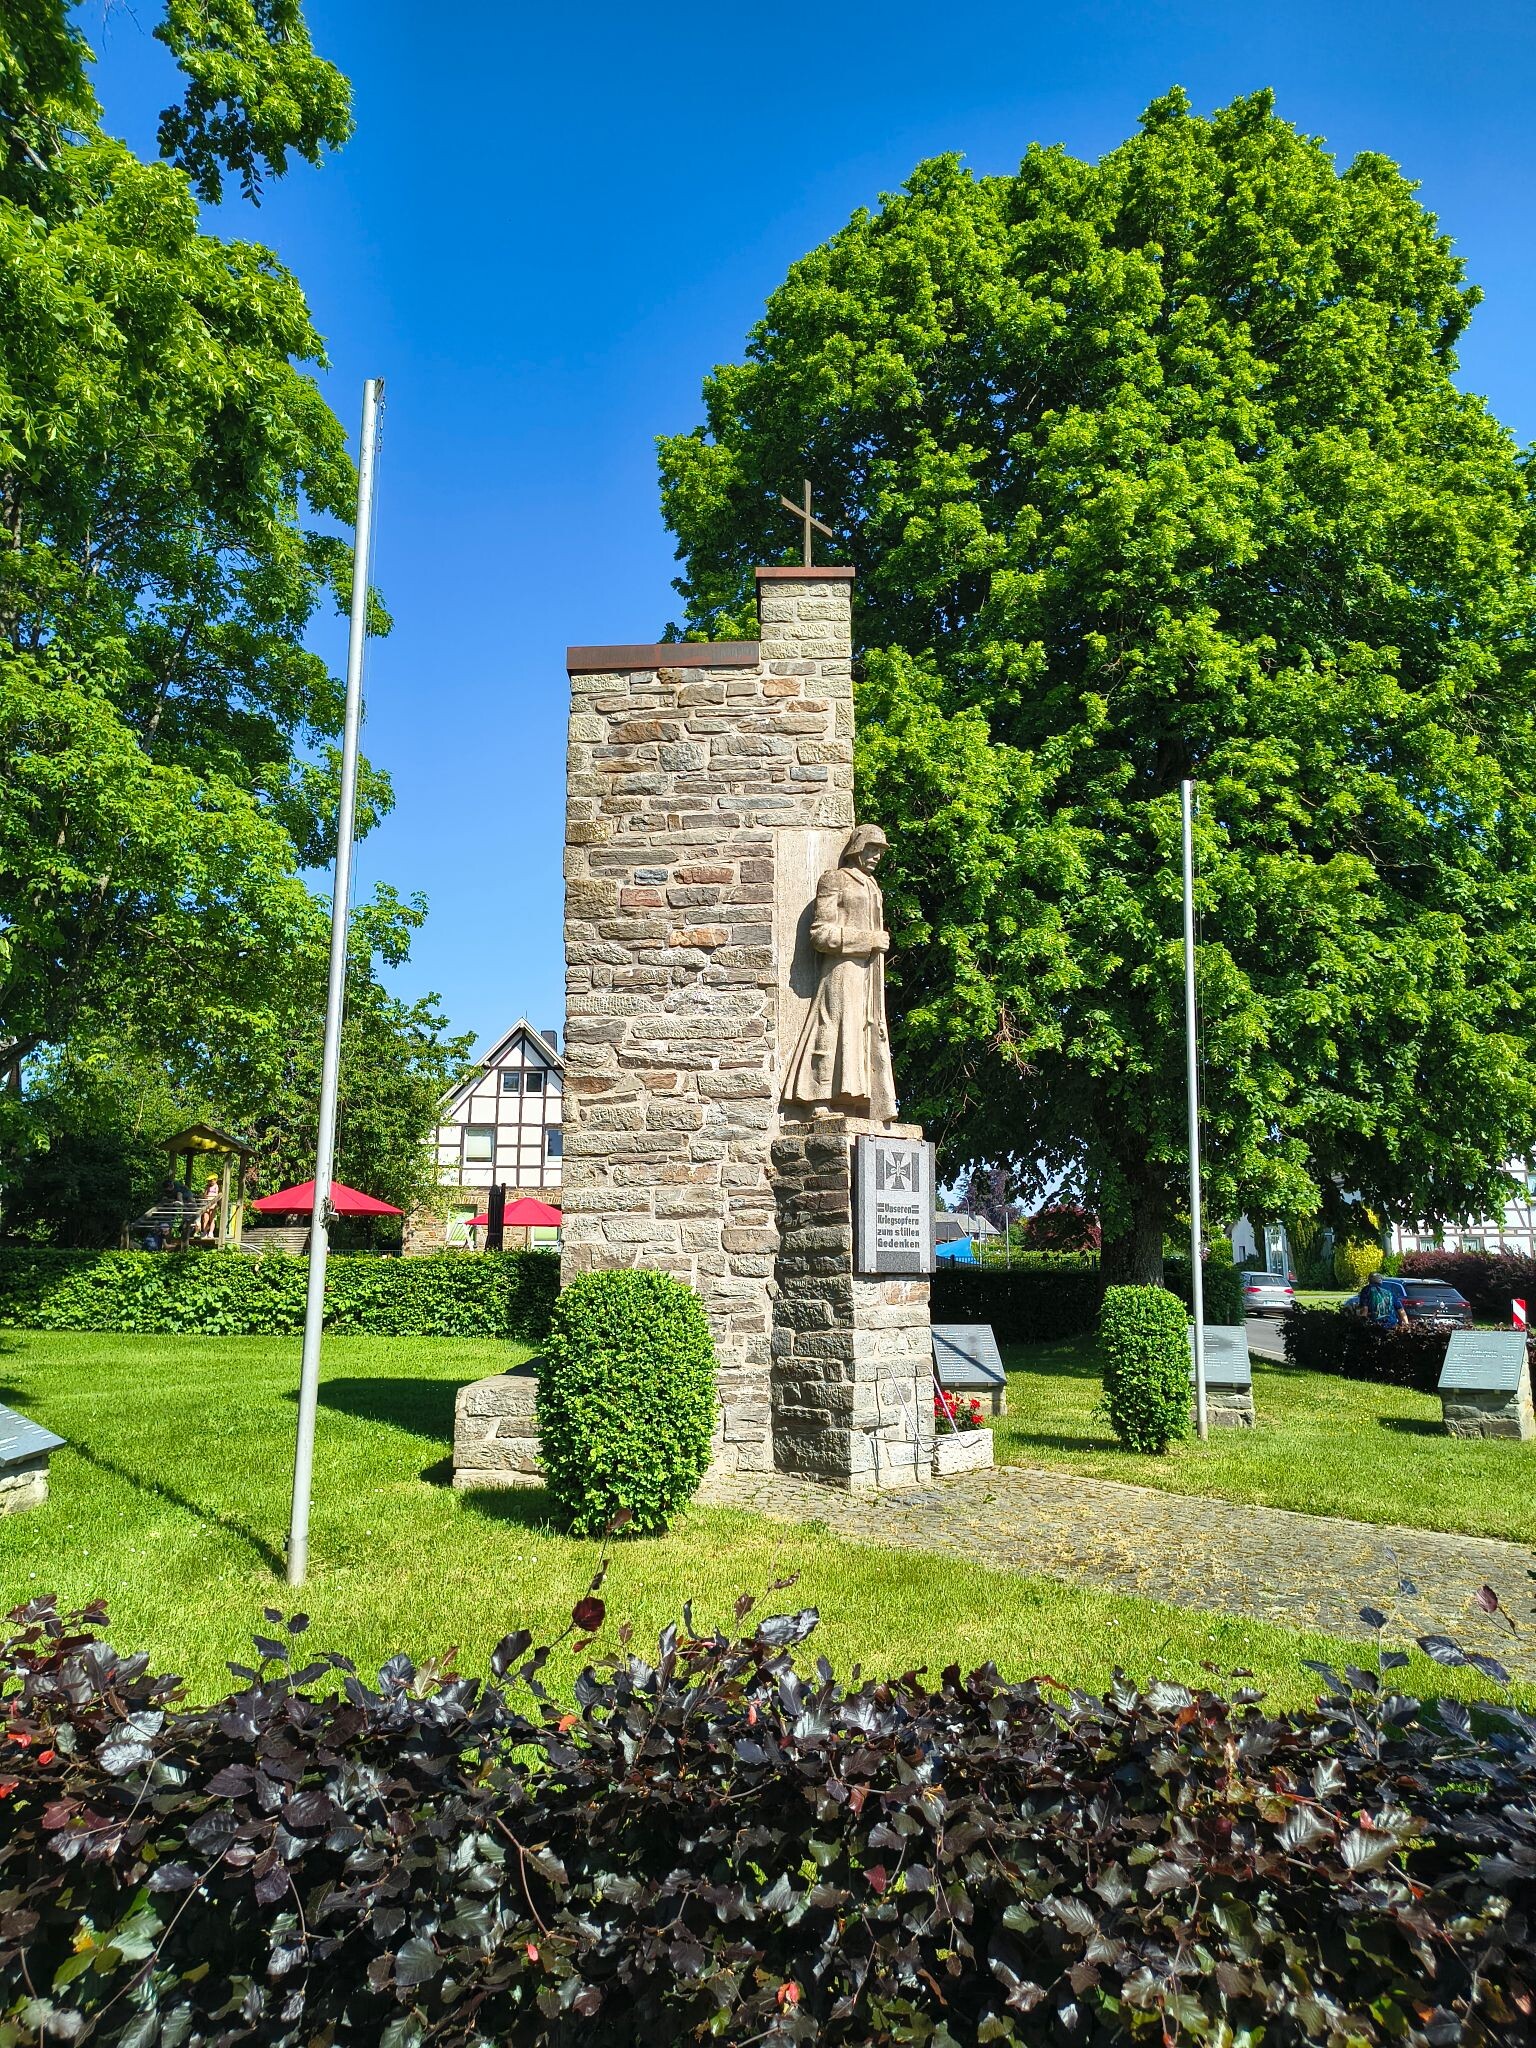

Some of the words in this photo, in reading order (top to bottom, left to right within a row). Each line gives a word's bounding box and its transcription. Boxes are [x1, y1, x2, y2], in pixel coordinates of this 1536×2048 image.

[885, 1203, 911, 1214] Unseren
[878, 1215, 919, 1226] Kriegsopfern
[895, 1227, 919, 1236] stillen
[878, 1238, 919, 1248] Gedenken
